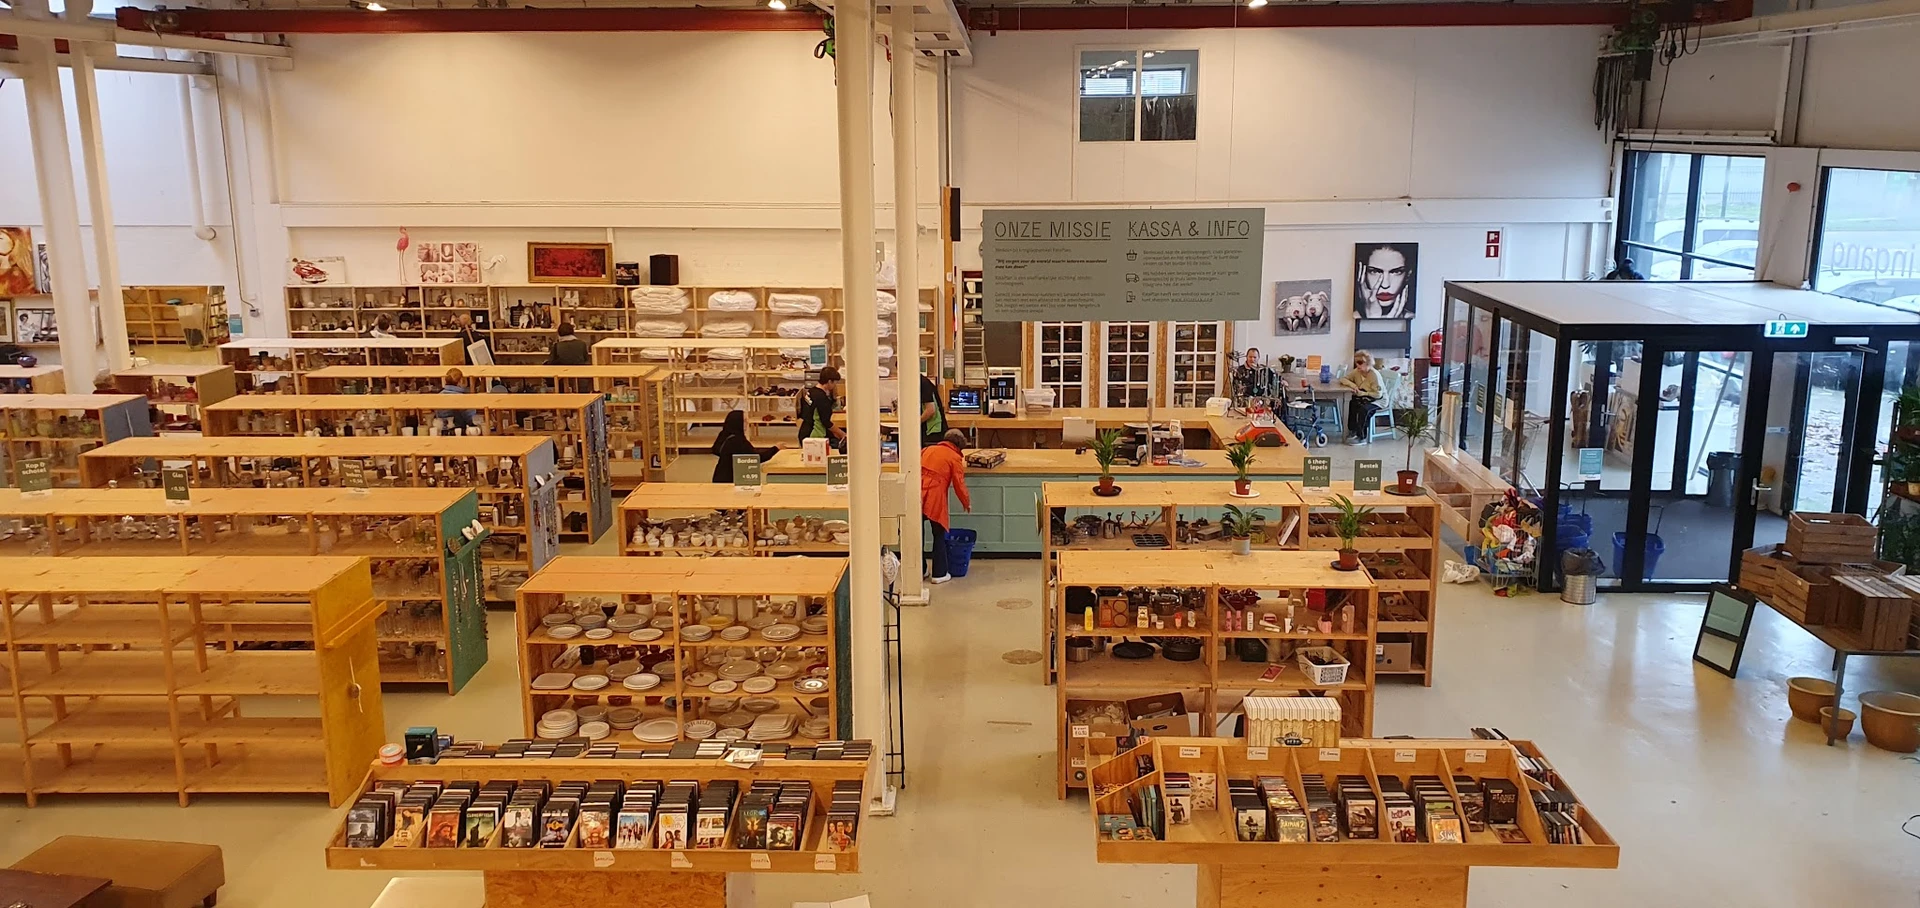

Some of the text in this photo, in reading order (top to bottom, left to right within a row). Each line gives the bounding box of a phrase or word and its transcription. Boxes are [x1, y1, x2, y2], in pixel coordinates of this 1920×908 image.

[995, 221, 1112, 238] ONZE MISSIE
[1128, 220, 1250, 237] KASSA & INFO
